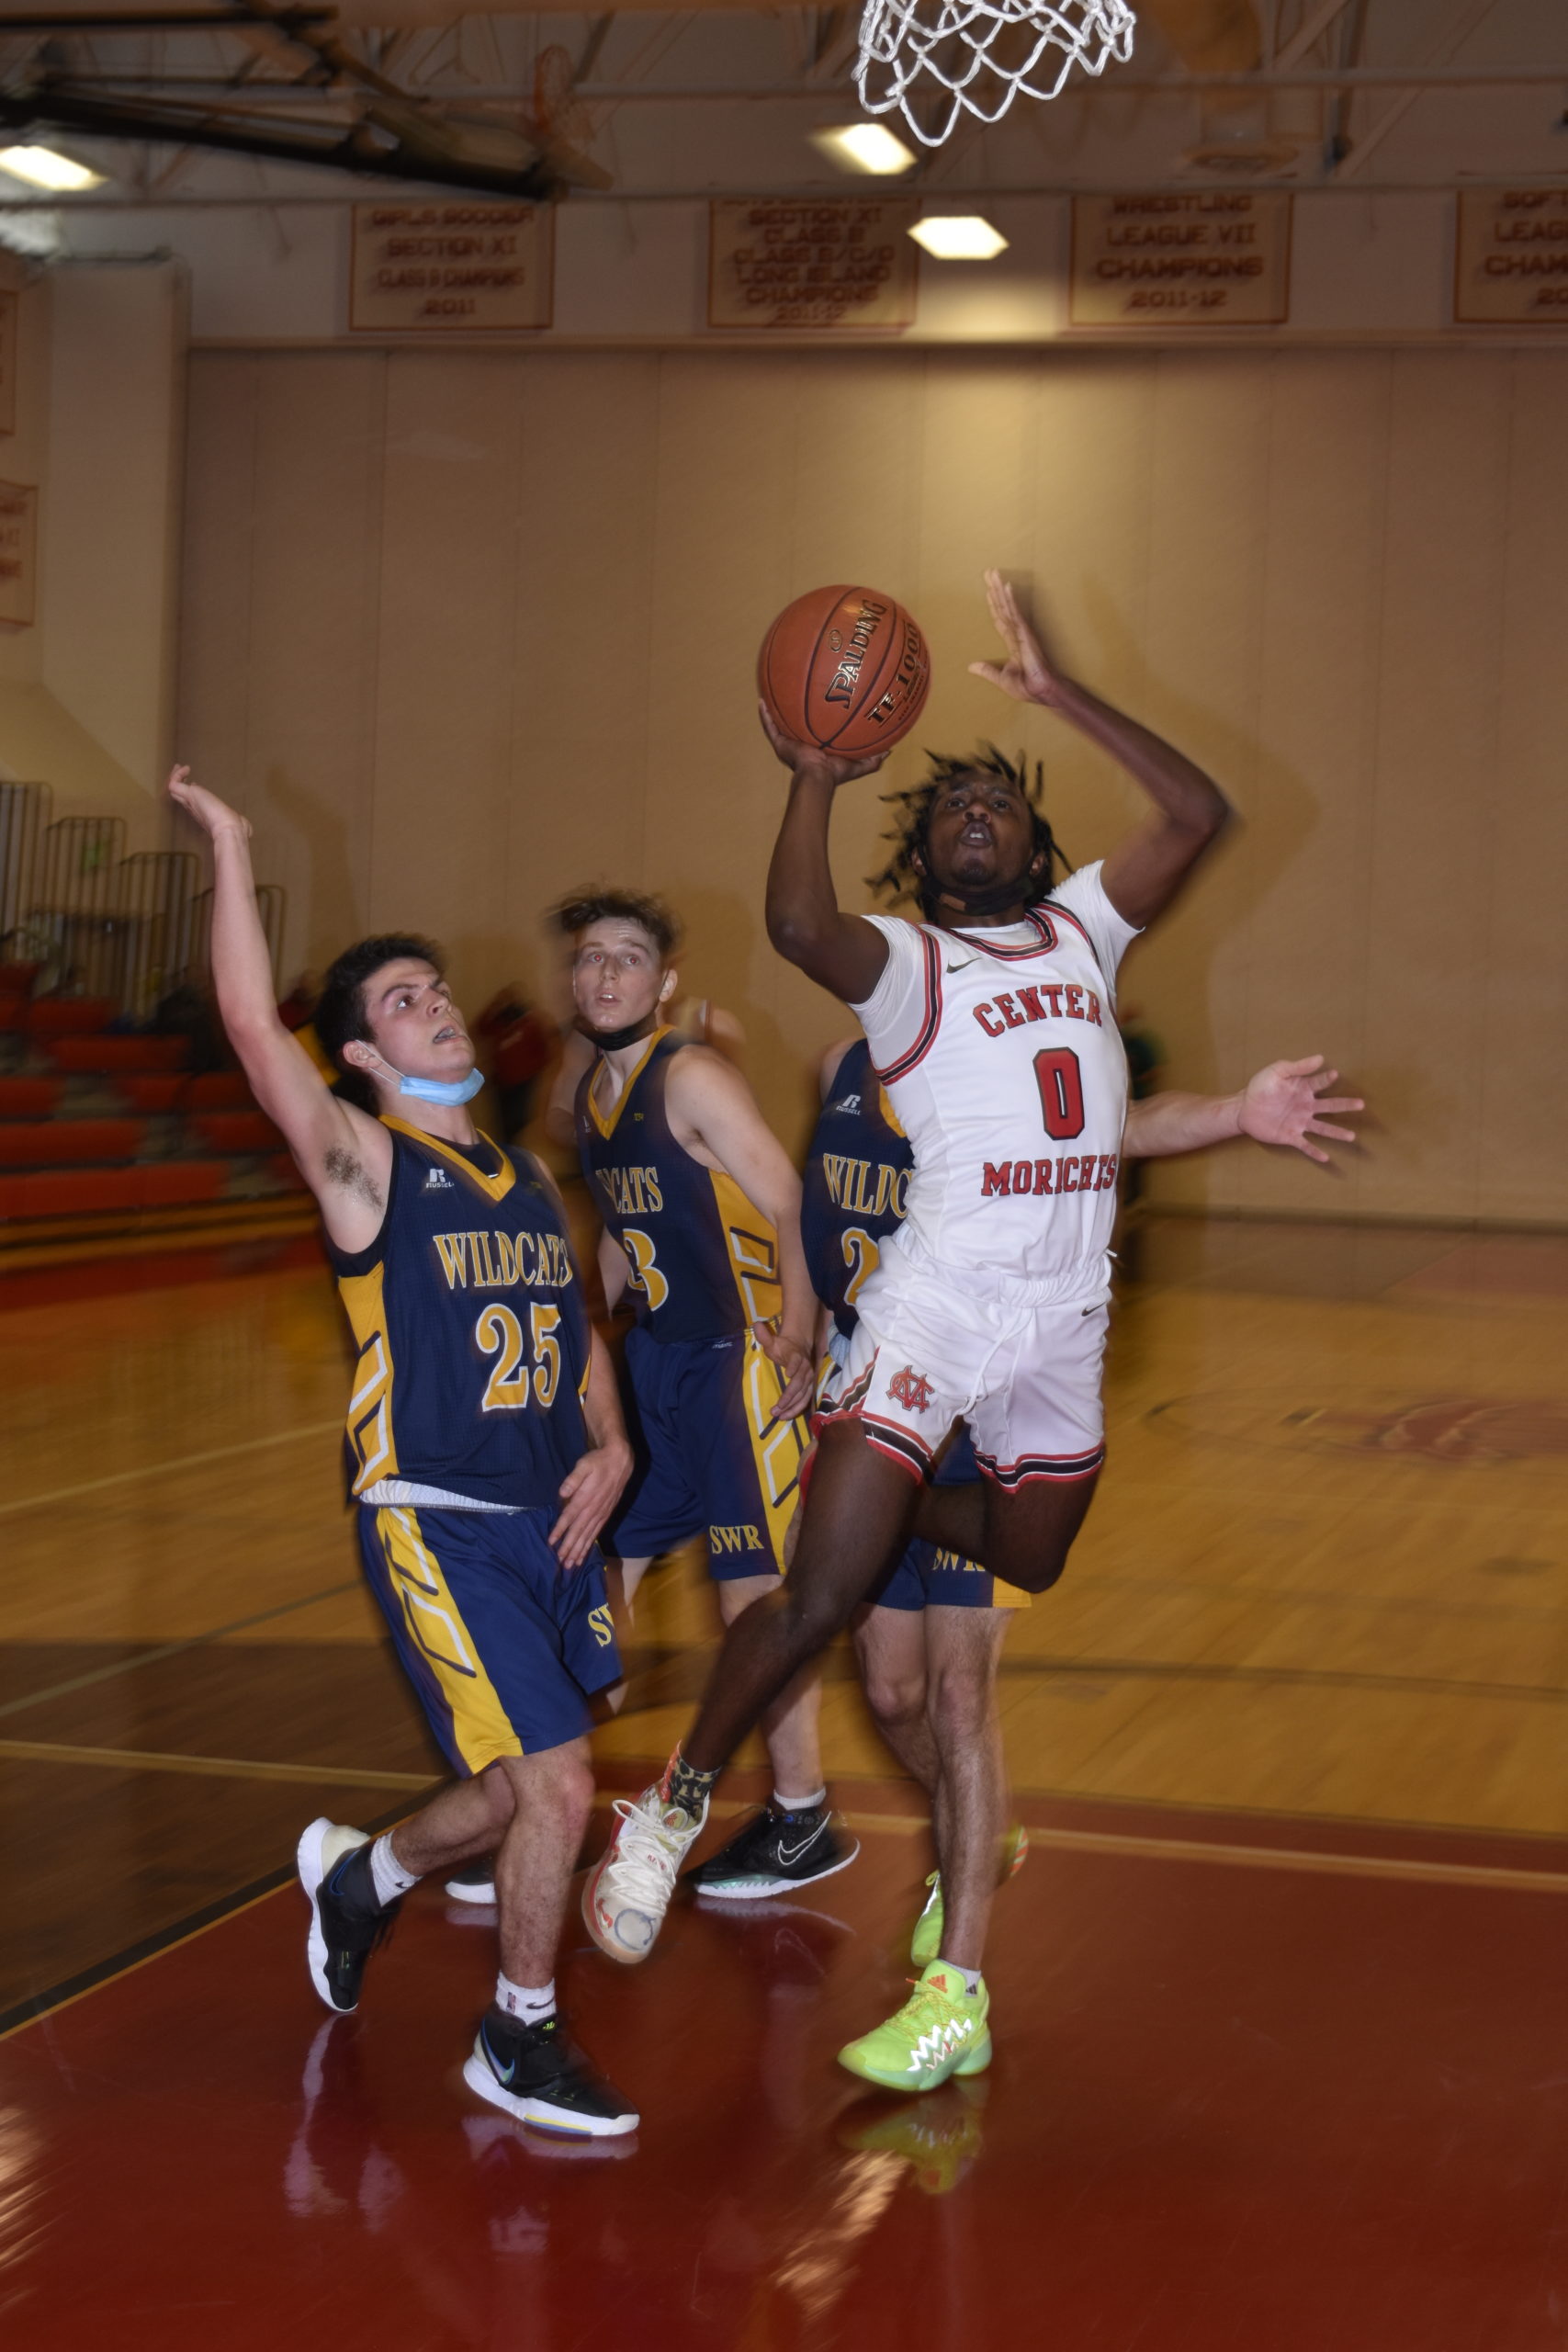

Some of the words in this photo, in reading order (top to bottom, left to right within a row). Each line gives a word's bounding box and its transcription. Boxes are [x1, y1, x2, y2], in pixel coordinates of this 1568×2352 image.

[1112, 195, 1253, 214] WRESTLING
[388, 236, 483, 256] SECTION
[491, 235, 518, 254] XI
[1107, 226, 1208, 246] LEAGUE
[1218, 223, 1257, 243] VII
[1495, 220, 1568, 242] LEAG
[1096, 256, 1264, 278] CHAMPIONS
[825, 599, 888, 710] SPALDING
[973, 984, 1102, 1037] CENTER
[1032, 1046, 1085, 1141] 0
[433, 1230, 573, 1289] WILDCATS
[476, 1301, 561, 1412] 25
[709, 1524, 764, 1555] SWR
